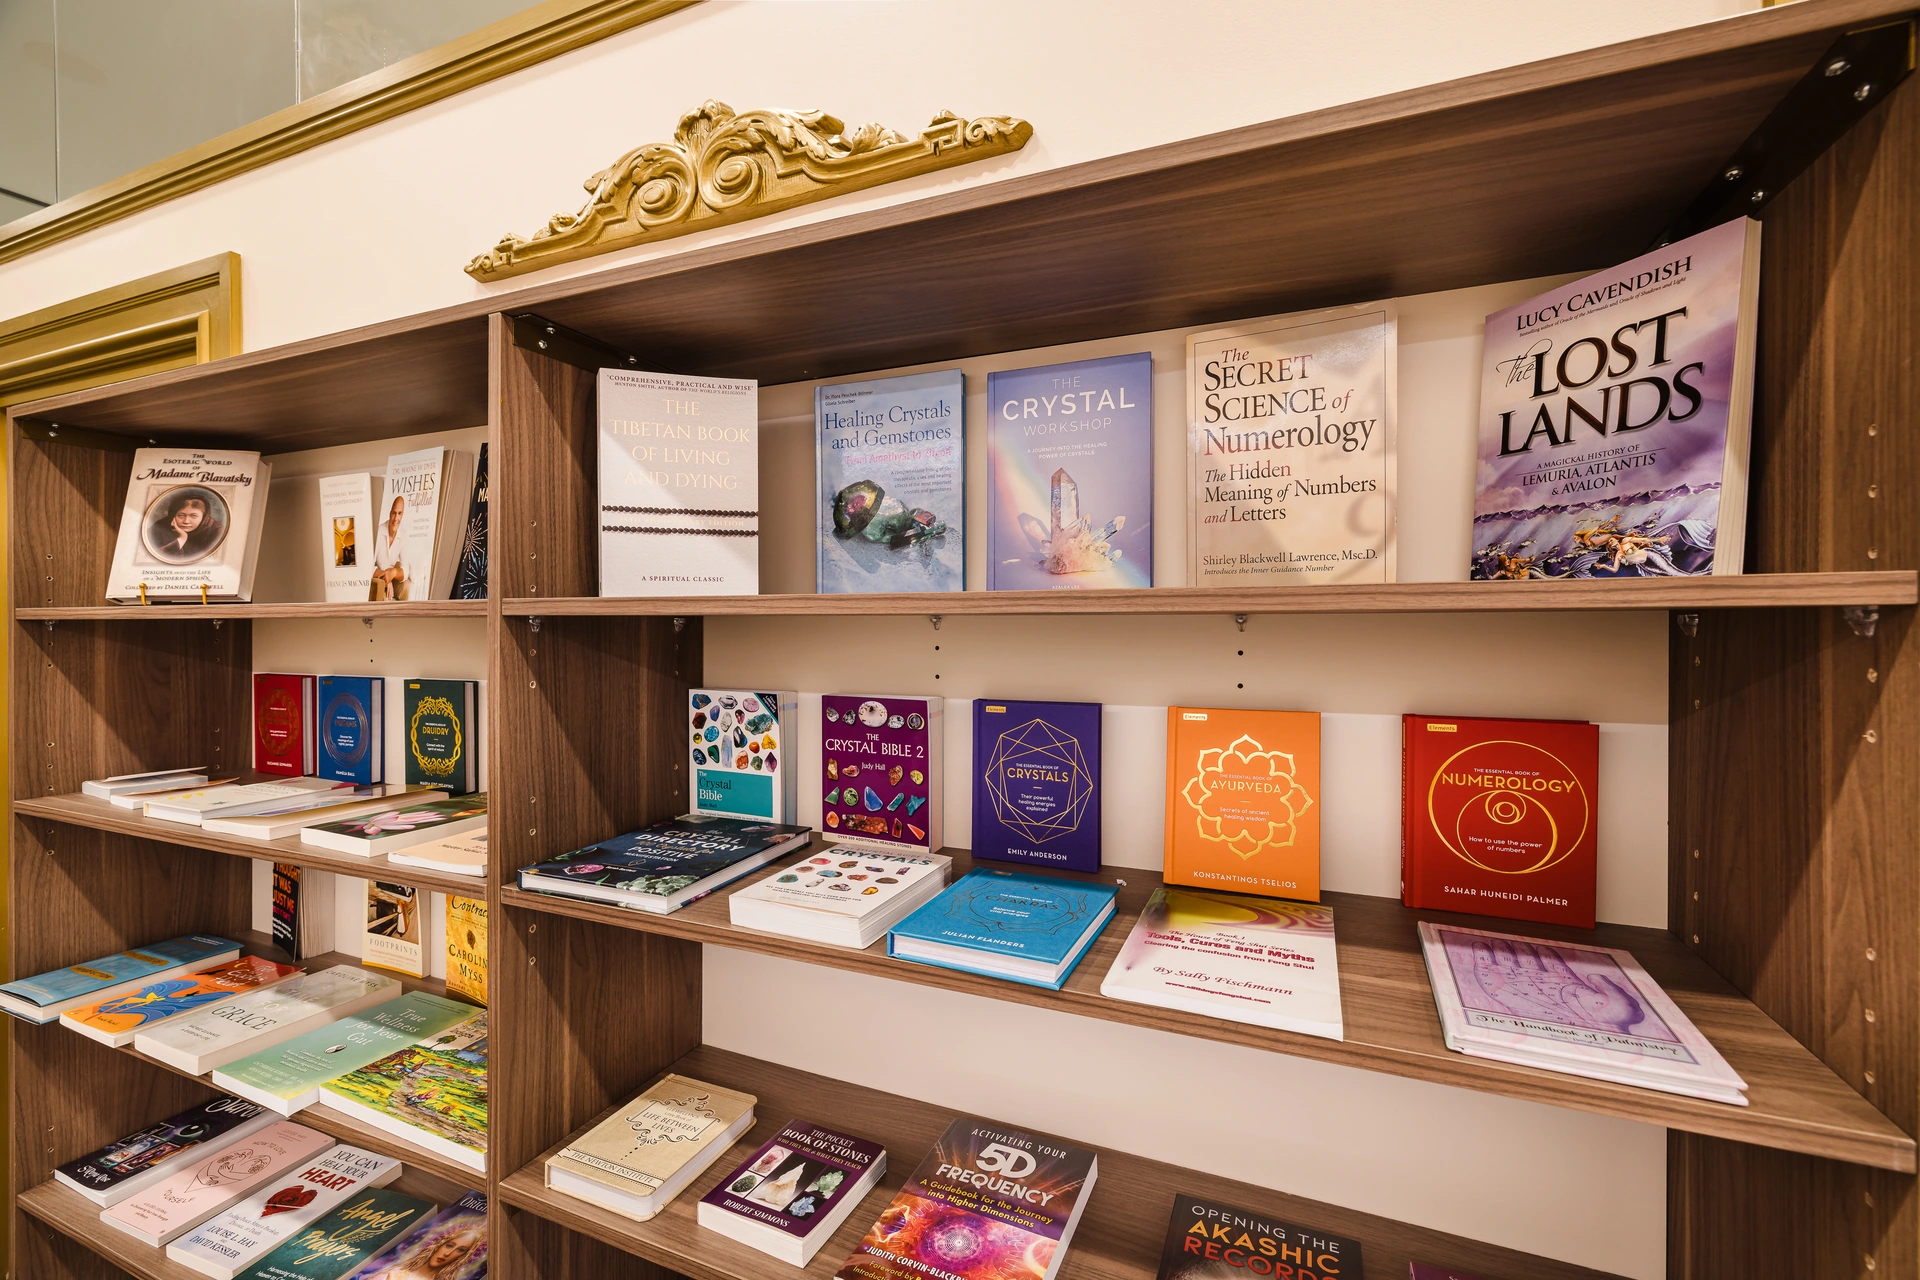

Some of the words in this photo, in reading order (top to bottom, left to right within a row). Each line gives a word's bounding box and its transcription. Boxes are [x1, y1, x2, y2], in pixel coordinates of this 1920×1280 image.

[1516, 302, 1564, 331] LUCY
[1567, 255, 1693, 313] CAVENDISH
[1221, 348, 1250, 364] The
[1529, 306, 1688, 400] LOST
[1052, 376, 1081, 390] THE
[1204, 354, 1313, 392] SECRET
[662, 399, 700, 416] THE
[824, 410, 884, 430] Healing
[888, 399, 951, 426] Crystals
[1002, 387, 1135, 421] CRYSTAL
[1204, 387, 1327, 424] SCIENCE
[1331, 389, 1354, 413] of
[1497, 361, 1703, 458] LANDS
[609, 419, 691, 439] TIBETAN
[698, 426, 750, 443] BOOK
[1023, 418, 1112, 436] WORKSHOP
[1204, 414, 1377, 456] Numerology
[831, 431, 859, 450] and
[864, 426, 951, 447] Gemstones
[632, 446, 657, 461] OF
[664, 448, 730, 466] LIVING
[1543, 455, 1586, 469] MAGICKAL
[1587, 446, 1626, 462] HISTORY
[1627, 444, 1641, 454] OF
[136, 468, 194, 480] Madame
[197, 471, 252, 486] Blavatsky
[624, 470, 669, 487] AND
[675, 473, 738, 490] DYING
[1205, 469, 1226, 483] The
[1229, 460, 1292, 481] Hidden
[1522, 468, 1583, 486] LEMURIA,
[1584, 453, 1656, 477] ATLANTIS
[391, 473, 436, 495] WISHES
[1204, 485, 1273, 505] Meaning
[1276, 483, 1292, 502] of
[1294, 475, 1377, 497] Numbers
[1551, 488, 1559, 496] &
[1561, 475, 1617, 495] AVALON
[407, 491, 434, 513] Fulfilled
[1204, 509, 1227, 524] and
[1230, 505, 1286, 523] Letters
[1203, 554, 1237, 567] Shirley
[1239, 551, 1286, 564] Blackwell
[1289, 551, 1340, 563] Lawrence,
[1342, 549, 1378, 561] Msc.D.
[1204, 567, 1237, 575] Introduces
[1250, 566, 1268, 574] Inner
[1270, 566, 1303, 574] Guidance
[1305, 565, 1334, 573] Number
[422, 726, 449, 736] DRUIDRY
[866, 733, 880, 742] THE
[825, 738, 877, 754] CRYSTAL
[881, 742, 912, 757] BIBLE
[916, 746, 924, 759] 2
[861, 762, 873, 771] Judy
[874, 762, 886, 771] Hall
[1007, 767, 1069, 783] CRYSTALS
[699, 777, 732, 791] Crystal
[1210, 780, 1282, 794] AYURVEDA
[1441, 772, 1575, 793] NUMEROLOGY
[699, 789, 722, 801] Bible
[635, 834, 746, 851] DIRECTORY
[664, 830, 741, 844] CRYSTAL
[829, 849, 932, 866] CRYSTALS
[1007, 848, 1028, 856] EMILY
[1029, 851, 1067, 861] ANDERSON
[1193, 871, 1258, 884] KONSTANTINOS
[1261, 878, 1297, 889] TSELIOS
[985, 894, 1059, 911] CHAKRAS
[1444, 885, 1477, 896] SAHAR
[1480, 890, 1523, 901] HUNEIDI
[1527, 895, 1568, 906] PALMER
[369, 938, 418, 956] FOOTPRINTS
[941, 930, 975, 940] JULIAN
[977, 936, 1025, 949] FLANDERS
[1147, 931, 1185, 944] Tools,
[1189, 938, 1231, 950] Cures
[1235, 945, 1263, 955] and
[1267, 950, 1316, 963] Myths
[1153, 966, 1173, 978] By
[1175, 969, 1211, 983] Sally
[1213, 976, 1294, 996] Fischmann
[211, 1005, 278, 1031] GRACE
[373, 1012, 420, 1033] Wellness
[399, 1008, 427, 1023] True
[346, 1020, 374, 1031] for
[373, 1026, 404, 1041] Your
[347, 1032, 374, 1046] Gut
[1476, 1014, 1507, 1025] The
[1510, 1019, 1580, 1037] Handbook
[1584, 1032, 1598, 1042] of
[1600, 1036, 1680, 1055] Palmistry
[643, 1112, 661, 1120] LIFE
[661, 1118, 700, 1133] BETWEEN
[652, 1123, 675, 1133] LIVES
[782, 1129, 815, 1144] BOOK
[813, 1139, 831, 1150] OF
[828, 1143, 872, 1164] STONES
[811, 1129, 826, 1139] THE
[823, 1134, 856, 1147] POCKET
[971, 1128, 1032, 1150] ACTIVATING
[1036, 1143, 1067, 1160] YOUR
[319, 1158, 341, 1171] HEAL
[343, 1165, 369, 1179] YOUR
[333, 1150, 358, 1164] YOU
[356, 1156, 382, 1171] CAN
[569, 1150, 586, 1160] THE
[586, 1157, 617, 1171] NEWTON
[616, 1166, 654, 1183] INSTITUTE
[975, 1142, 1037, 1179] 5D
[298, 1167, 357, 1191] HEART
[935, 1163, 1055, 1208] FREQUENCY
[927, 1188, 945, 1200] into
[947, 1194, 978, 1211] Higher
[981, 1204, 1035, 1229] Dimensions
[930, 1178, 979, 1200] Guidebook
[981, 1192, 996, 1204] for
[997, 1198, 1012, 1211] the
[1014, 1204, 1054, 1225] Journey
[328, 1198, 415, 1241] Angel
[723, 1199, 755, 1214] ROBERT
[752, 1209, 790, 1227] SIMMONS
[1192, 1205, 1286, 1240] OPENING
[1298, 1233, 1340, 1254] THE
[291, 1229, 361, 1265] Prayers
[1188, 1219, 1340, 1274] AKASHIC
